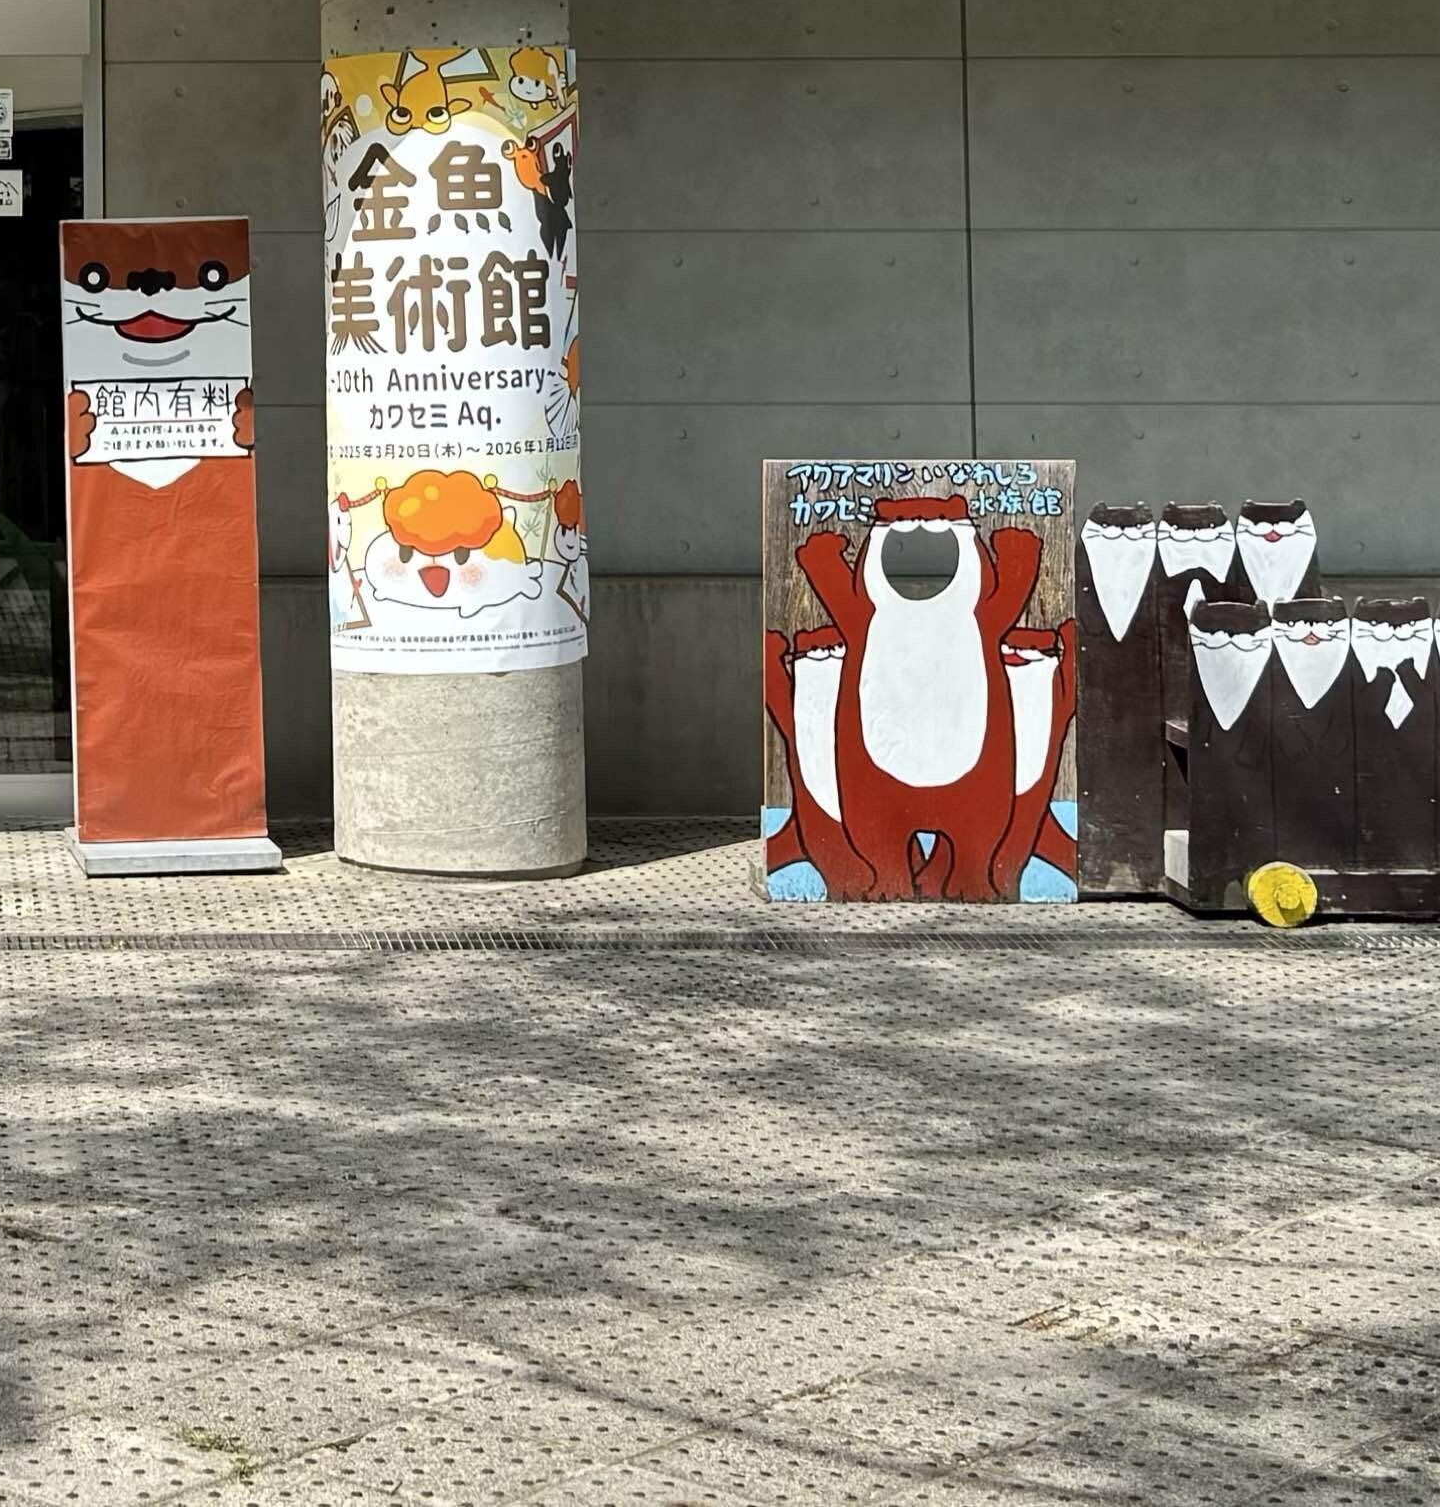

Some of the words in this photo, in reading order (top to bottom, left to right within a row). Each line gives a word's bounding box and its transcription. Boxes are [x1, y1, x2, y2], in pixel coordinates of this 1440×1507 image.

[348, 140, 513, 242] 金魚
[330, 249, 551, 356] 美術館
[96, 382, 232, 418] 館内有料
[370, 403, 448, 430] カワセミ
[457, 401, 502, 432] Aq.
[788, 493, 872, 527] カワセミ
[970, 487, 1063, 517] 水族館
